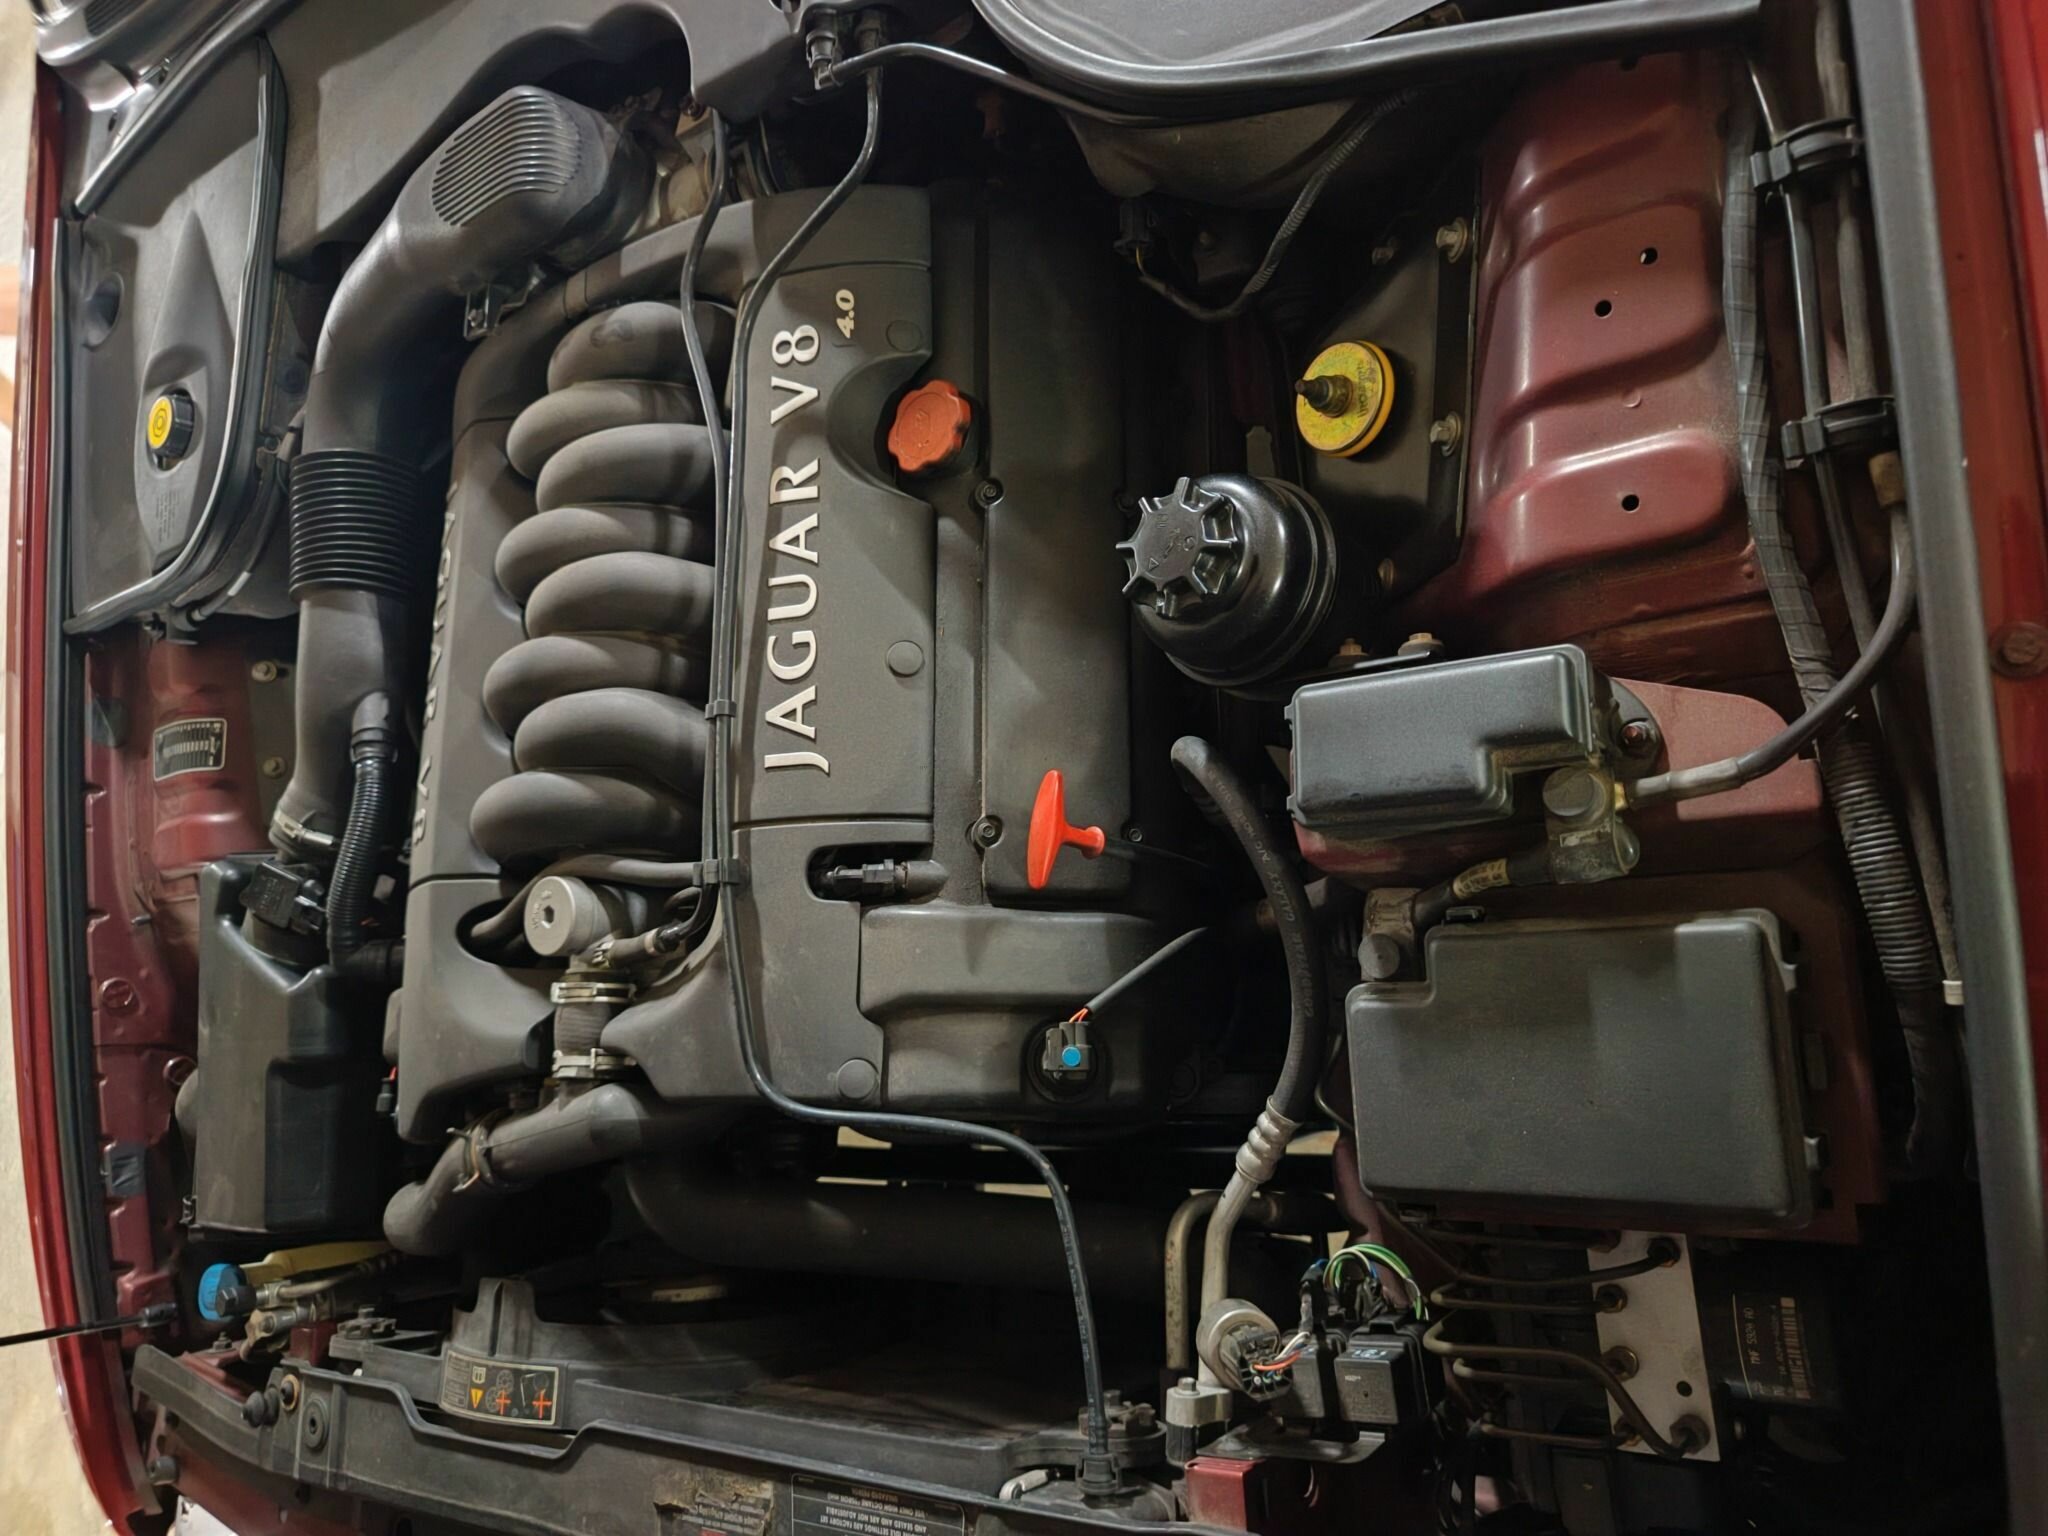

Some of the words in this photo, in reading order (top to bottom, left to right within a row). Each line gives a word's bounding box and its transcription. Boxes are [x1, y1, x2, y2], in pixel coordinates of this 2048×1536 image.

[835, 289, 855, 339] 4.0
[770, 324, 820, 426] V8
[764, 457, 830, 775] JAGUAR
[1255, 840, 1271, 863] A/C
[1267, 871, 1295, 922] GALAXY
